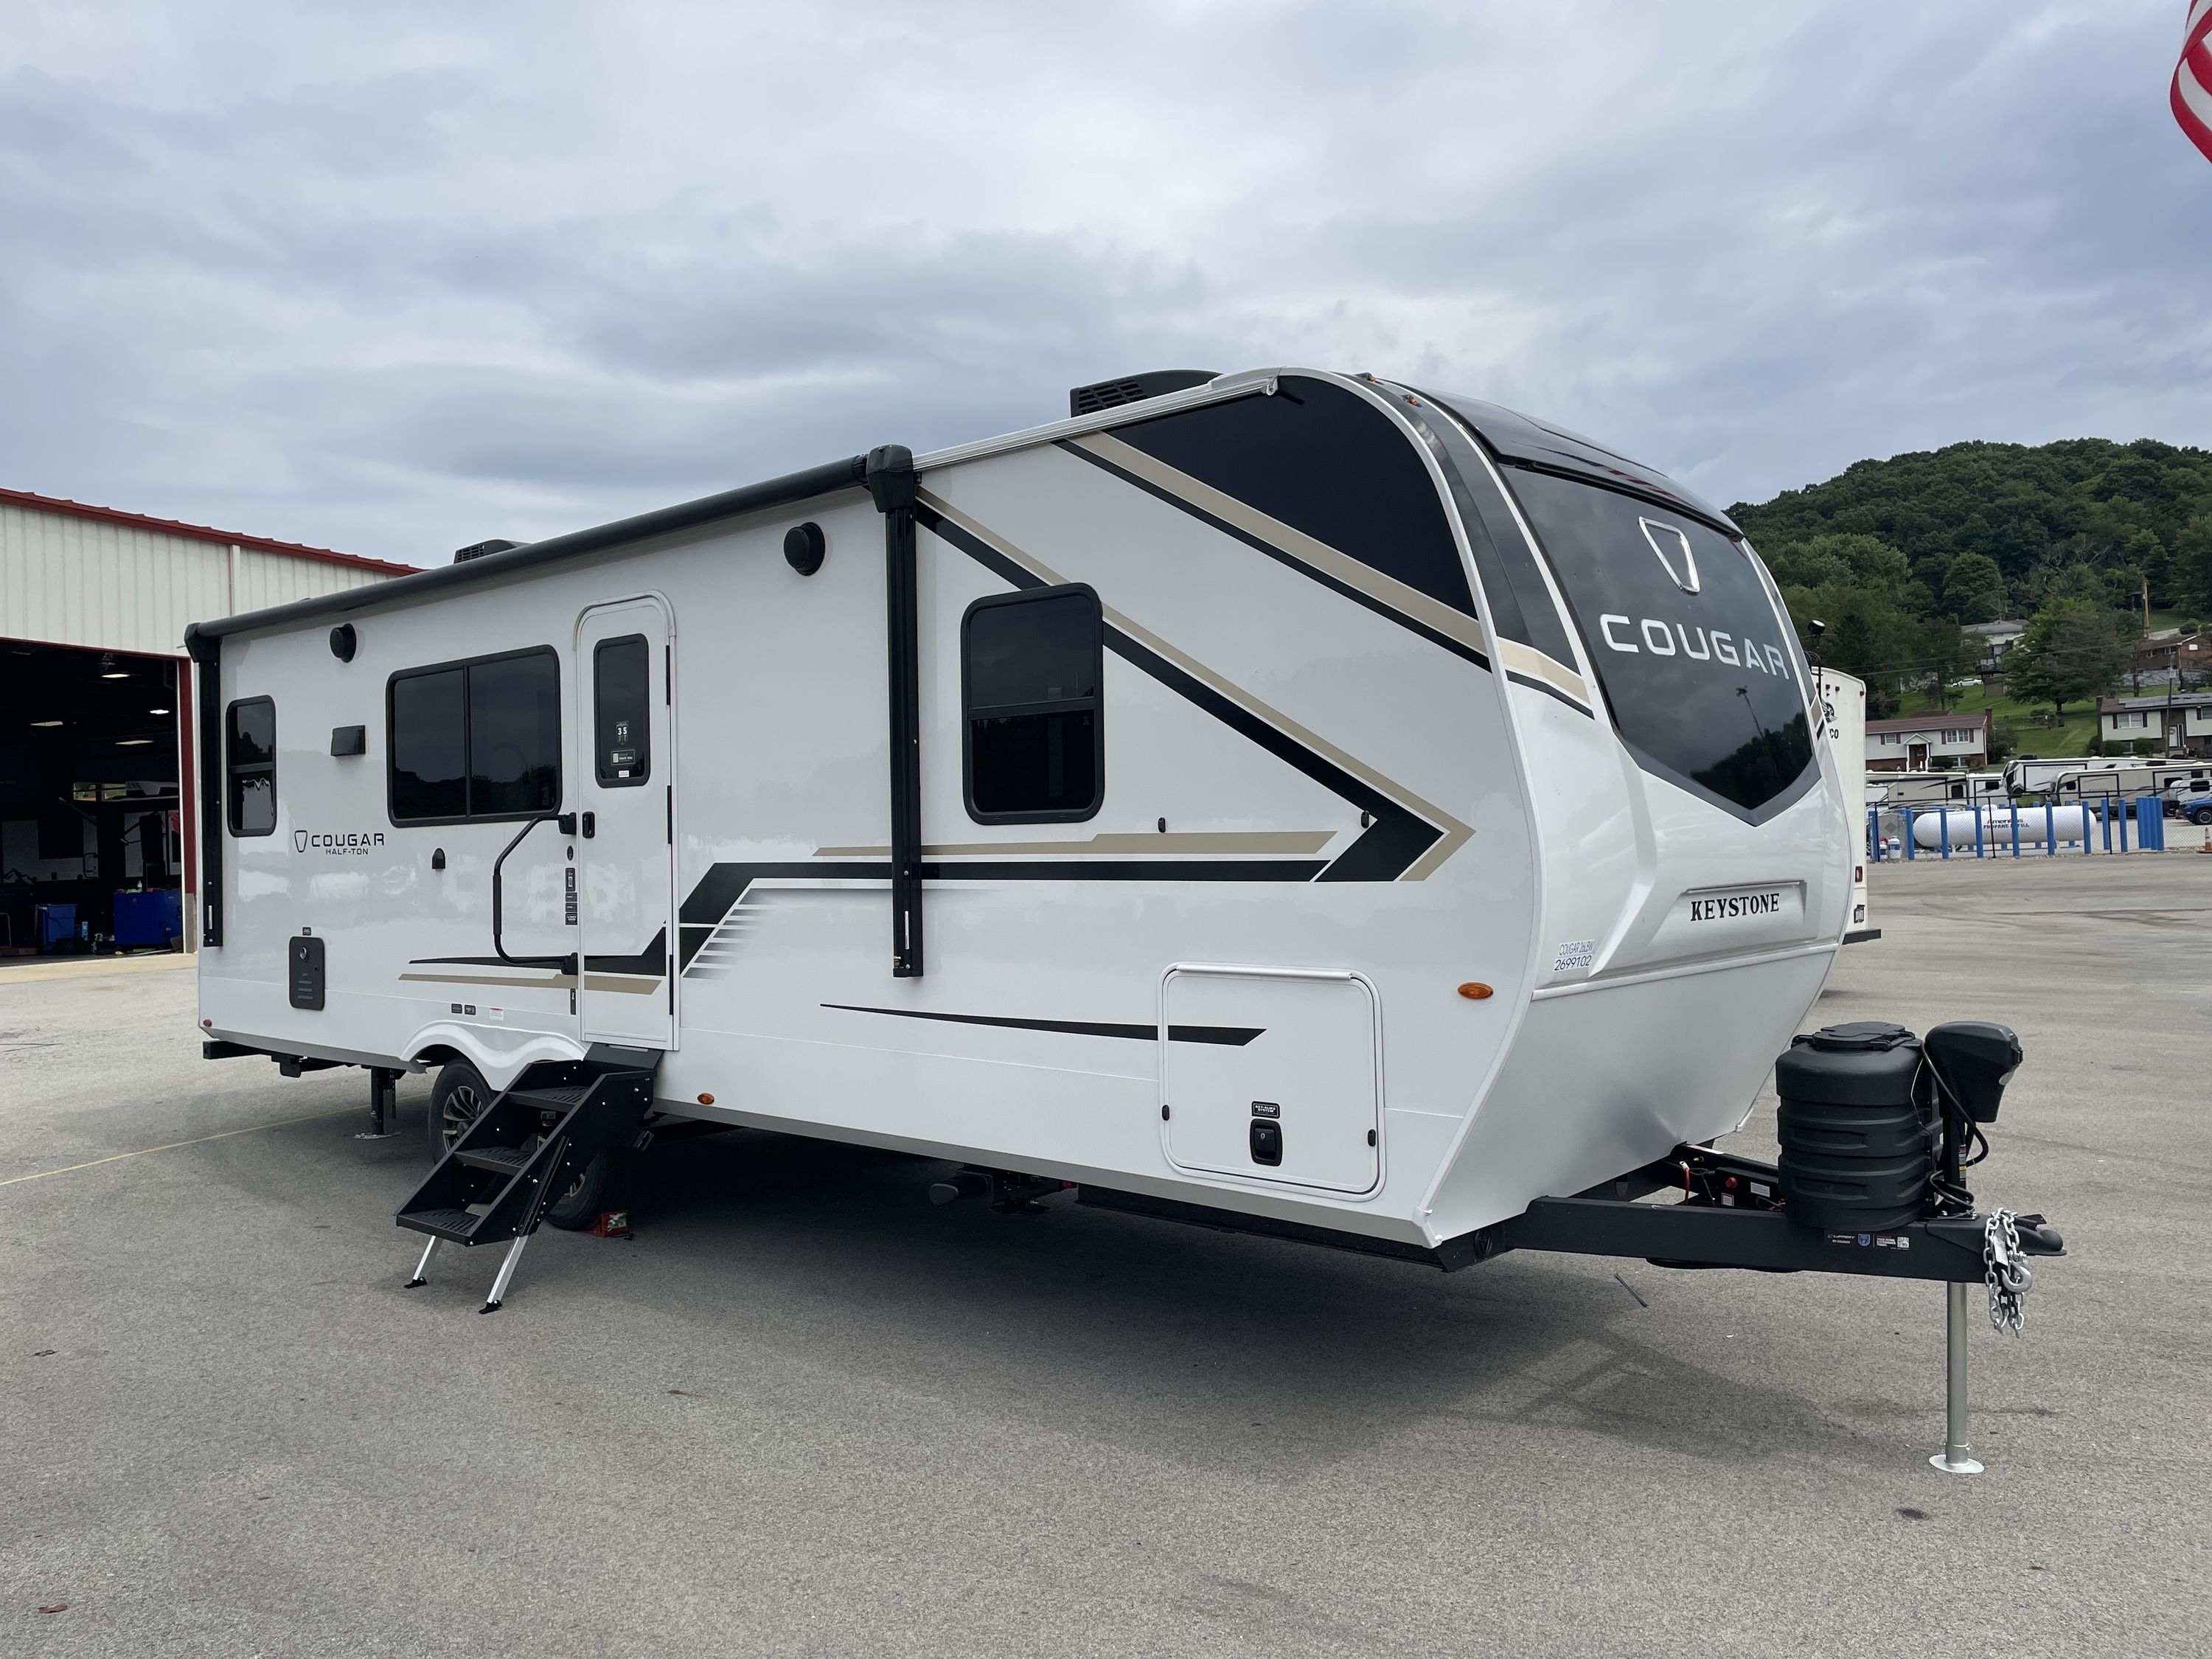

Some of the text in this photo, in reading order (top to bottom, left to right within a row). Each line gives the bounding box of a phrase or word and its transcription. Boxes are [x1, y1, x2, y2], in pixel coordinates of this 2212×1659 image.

[1599, 613, 1790, 680] COUGAR
[1828, 728, 1840, 740] CO
[311, 833, 385, 847] COUGAR
[1690, 893, 1780, 922] KEYSTONE
[1559, 942, 1580, 956] COUGAR
[1554, 955, 1592, 971] 2699102
